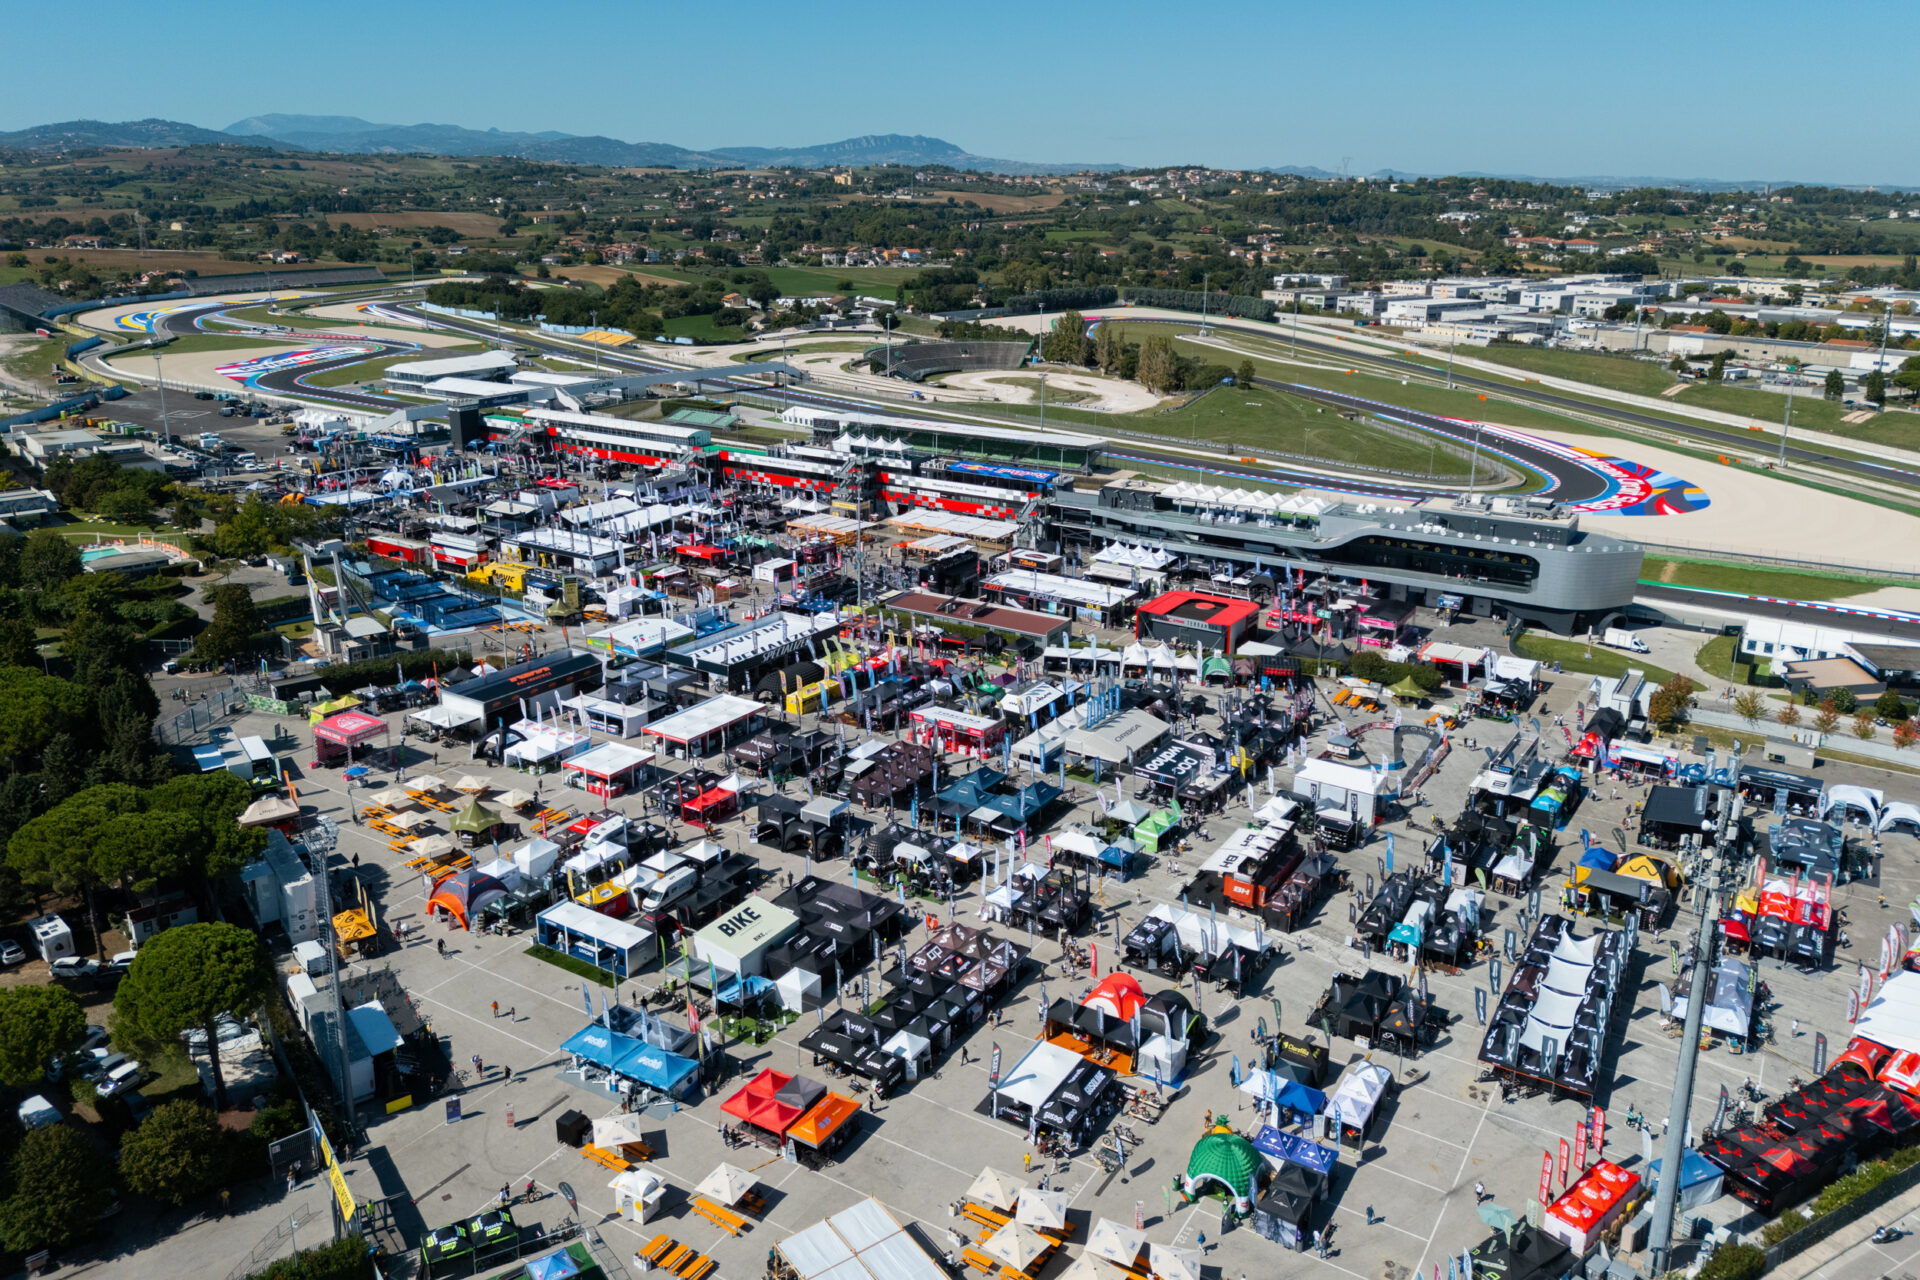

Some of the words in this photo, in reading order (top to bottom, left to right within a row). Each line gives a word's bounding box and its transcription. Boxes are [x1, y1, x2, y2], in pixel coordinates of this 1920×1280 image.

[762, 634, 813, 663] SPECIALIZE
[1114, 723, 1142, 743] ORBEA
[751, 739, 773, 750] HEAD
[1145, 745, 1186, 772] wahoo
[1232, 885, 1250, 896] BH
[718, 906, 762, 937] BIKE
[821, 1042, 840, 1054] uvex
[866, 1060, 882, 1071] uvex
